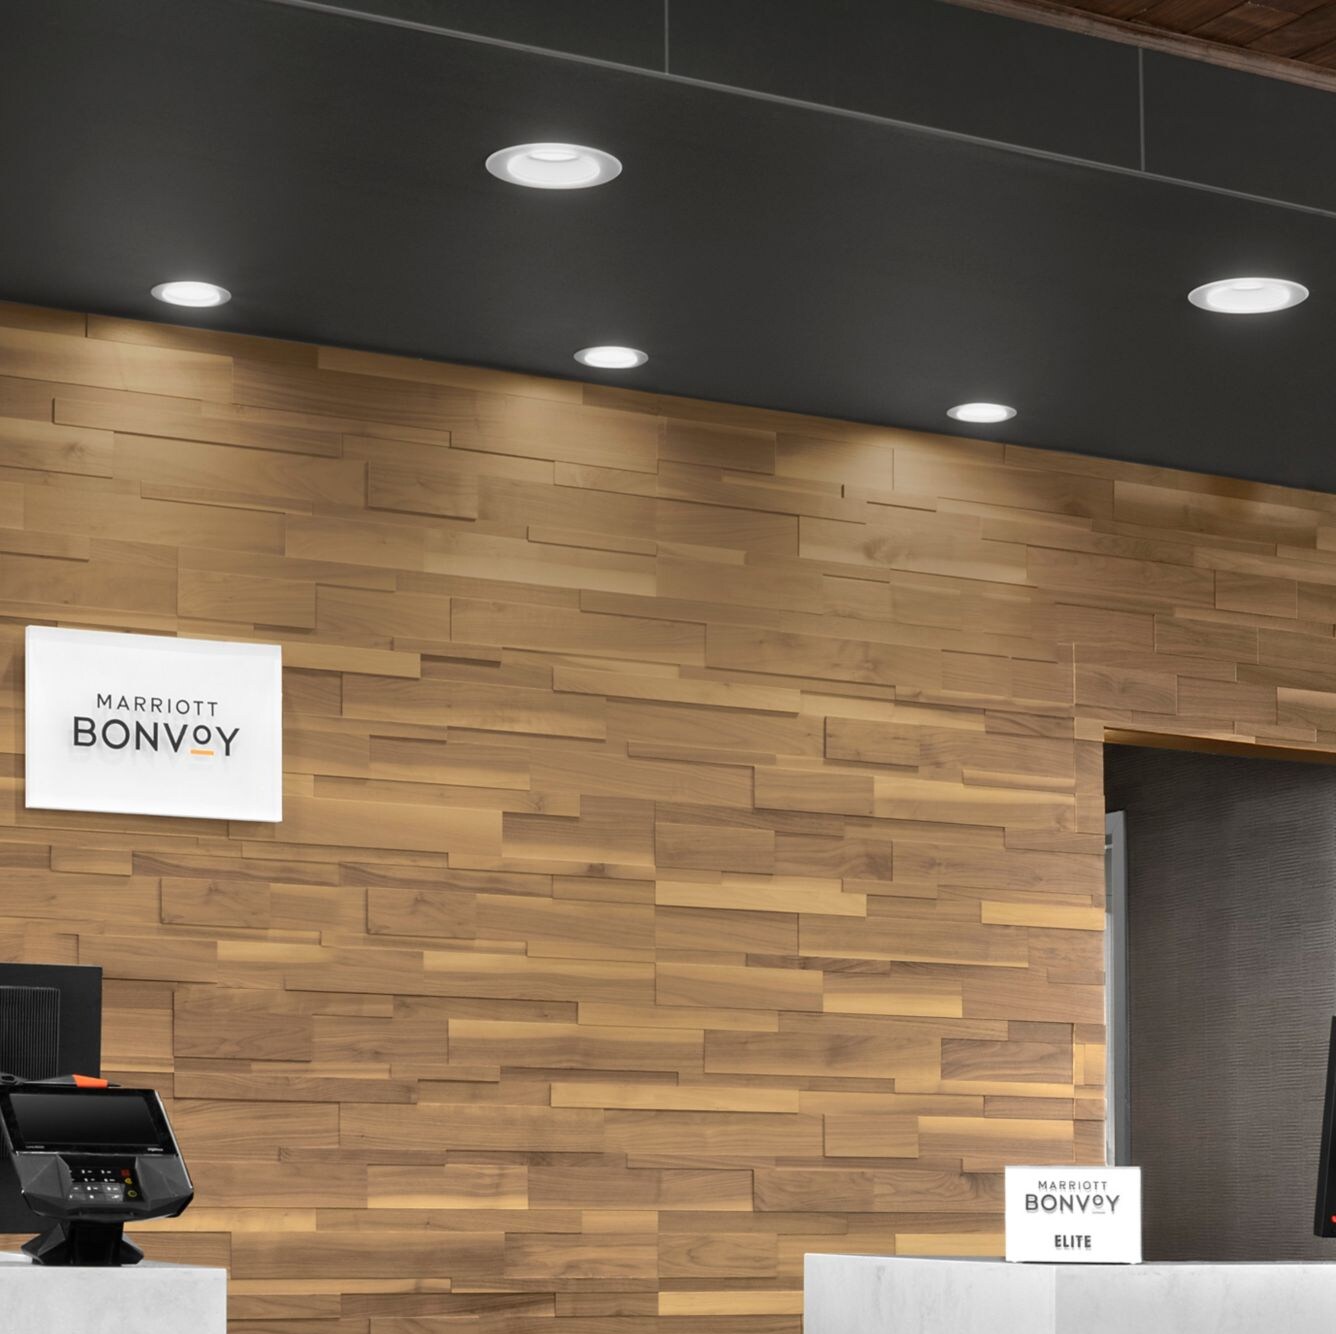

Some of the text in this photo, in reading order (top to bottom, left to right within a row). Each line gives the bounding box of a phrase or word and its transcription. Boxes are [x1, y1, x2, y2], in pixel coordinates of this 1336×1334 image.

[96, 693, 218, 716] MARRIOTT
[1038, 1180, 1107, 1190] MARRIOTT
[1054, 1234, 1092, 1248] ELITE
